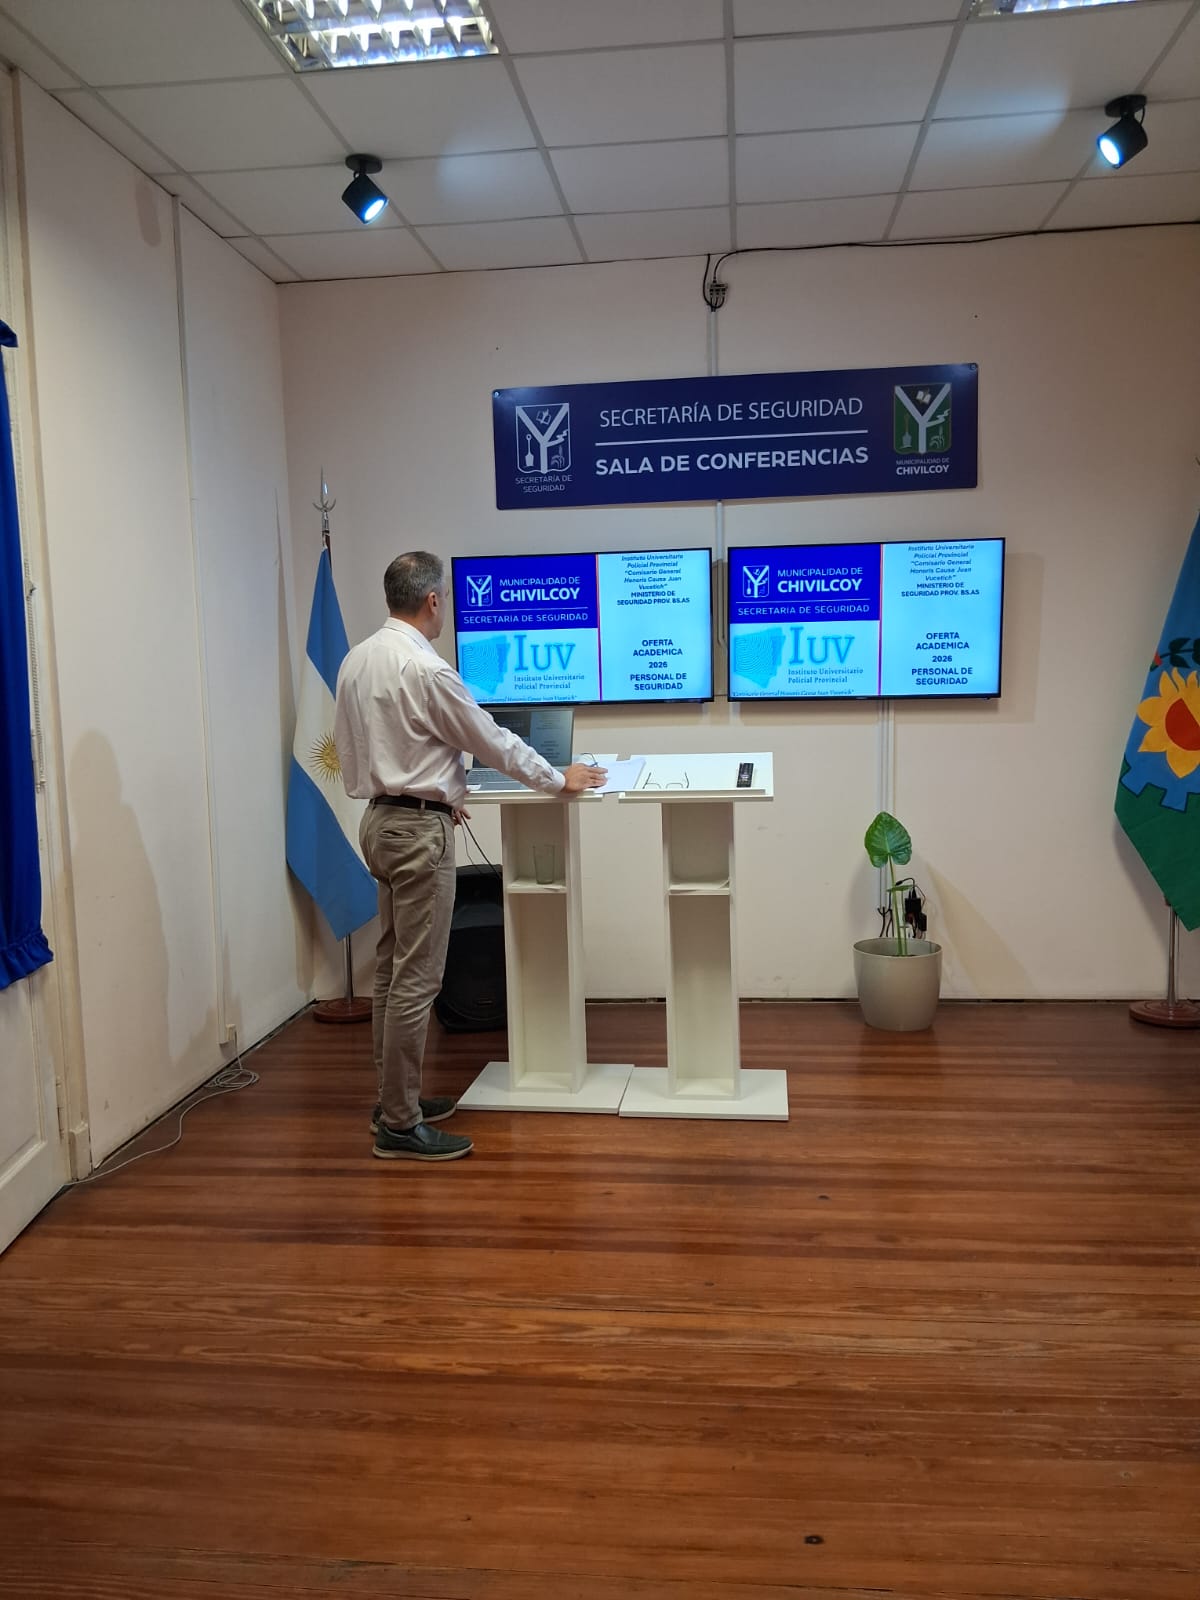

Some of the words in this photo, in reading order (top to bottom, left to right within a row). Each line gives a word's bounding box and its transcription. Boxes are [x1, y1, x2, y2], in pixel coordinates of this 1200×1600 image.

[600, 402, 711, 427] SECRETARÍA
[718, 403, 743, 421] DE
[749, 397, 863, 420] SEGURIDAD
[595, 457, 653, 475] SALA
[660, 455, 689, 472] DE
[697, 446, 869, 471] CONFERENCIAS
[896, 457, 940, 465] MUNICIPALIDAD
[896, 464, 949, 475] CHIVILCOY
[562, 474, 573, 482] DE
[523, 484, 565, 493] SEGURIDAD
[778, 568, 849, 577] MUNICIPALIDAD
[850, 567, 863, 575] DE
[500, 577, 567, 586] MUNICIPALIDAD
[568, 576, 580, 585] DE
[778, 578, 862, 593] CHIVILCOY
[500, 587, 580, 602] CHIVILCOY
[799, 606, 811, 614] DE
[815, 604, 870, 614] SEGURIDAD
[521, 614, 533, 622] DE
[536, 612, 588, 622] SEGURIDAD
[926, 631, 960, 640] OFERTA
[641, 639, 674, 647] OFERTA
[916, 641, 970, 650] ACADEMICA
[633, 648, 683, 657] ACADEMICA
[932, 655, 953, 663] 2026
[648, 661, 668, 669] 2026
[788, 668, 818, 676] Instituto
[819, 667, 864, 675] Universitario
[911, 667, 958, 676] PERSONAL
[960, 667, 973, 675] DE
[630, 673, 674, 681] PERSONAL
[675, 672, 687, 680] DE
[788, 676, 813, 684] Policial
[539, 682, 571, 690] Provincial
[915, 677, 968, 686] SEGURIDAD
[634, 682, 683, 691] SEGURIDAD
